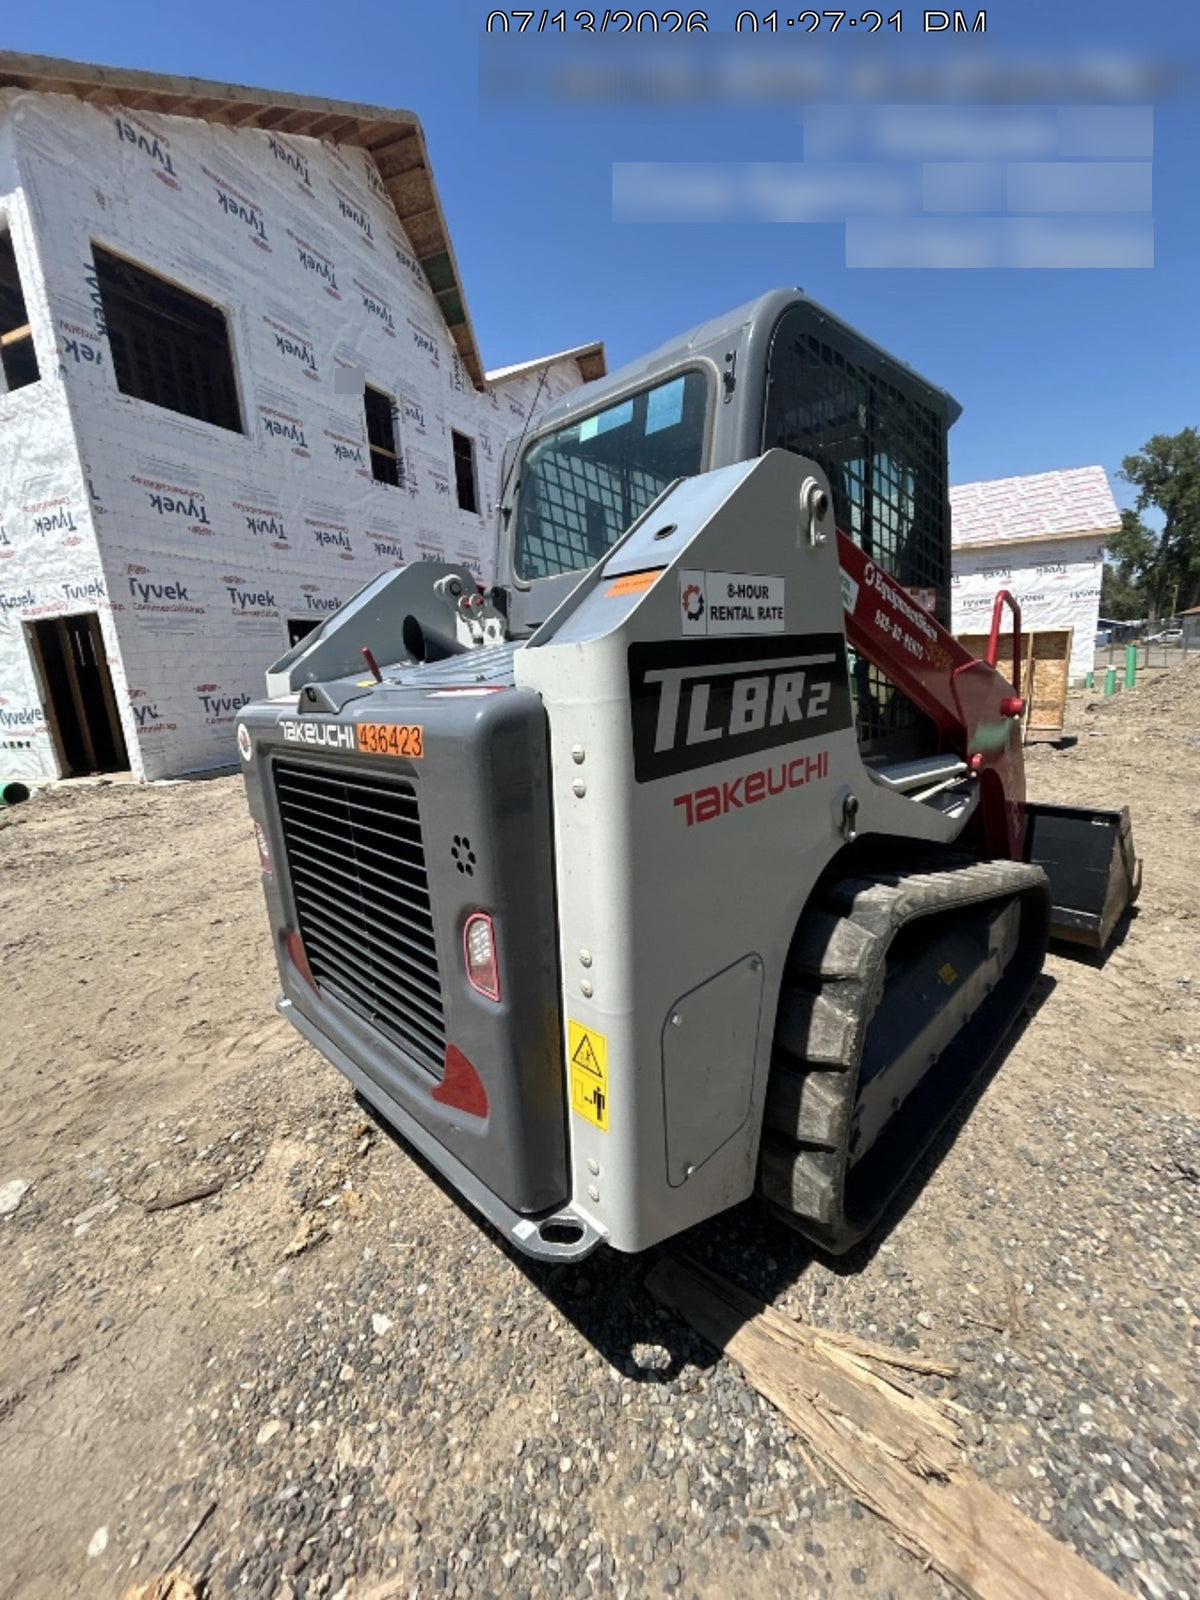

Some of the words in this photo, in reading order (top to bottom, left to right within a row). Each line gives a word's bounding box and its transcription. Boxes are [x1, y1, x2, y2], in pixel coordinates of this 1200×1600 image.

[267, 137, 313, 188] Tyvek
[217, 190, 269, 241] Tyvek
[338, 199, 375, 241] Tyvek
[296, 247, 340, 291] Tyvek
[274, 332, 320, 371] Tyvek
[261, 416, 309, 448] Tyvek
[33, 506, 78, 538] Tyvek
[149, 493, 212, 525] Tyvek
[313, 530, 353, 552] Tyvek
[374, 542, 405, 561] Tyvek
[62, 578, 107, 601] Tyvek
[128, 576, 192, 604] Tyvek
[226, 587, 278, 610] Tyvek
[726, 583, 770, 601] 8-HOUR
[709, 605, 755, 622] RENTAL
[757, 604, 785, 621] RATE
[279, 720, 356, 750] TAKEUCHI
[358, 724, 423, 757] 436423
[673, 750, 830, 828] TAKEUCHI
